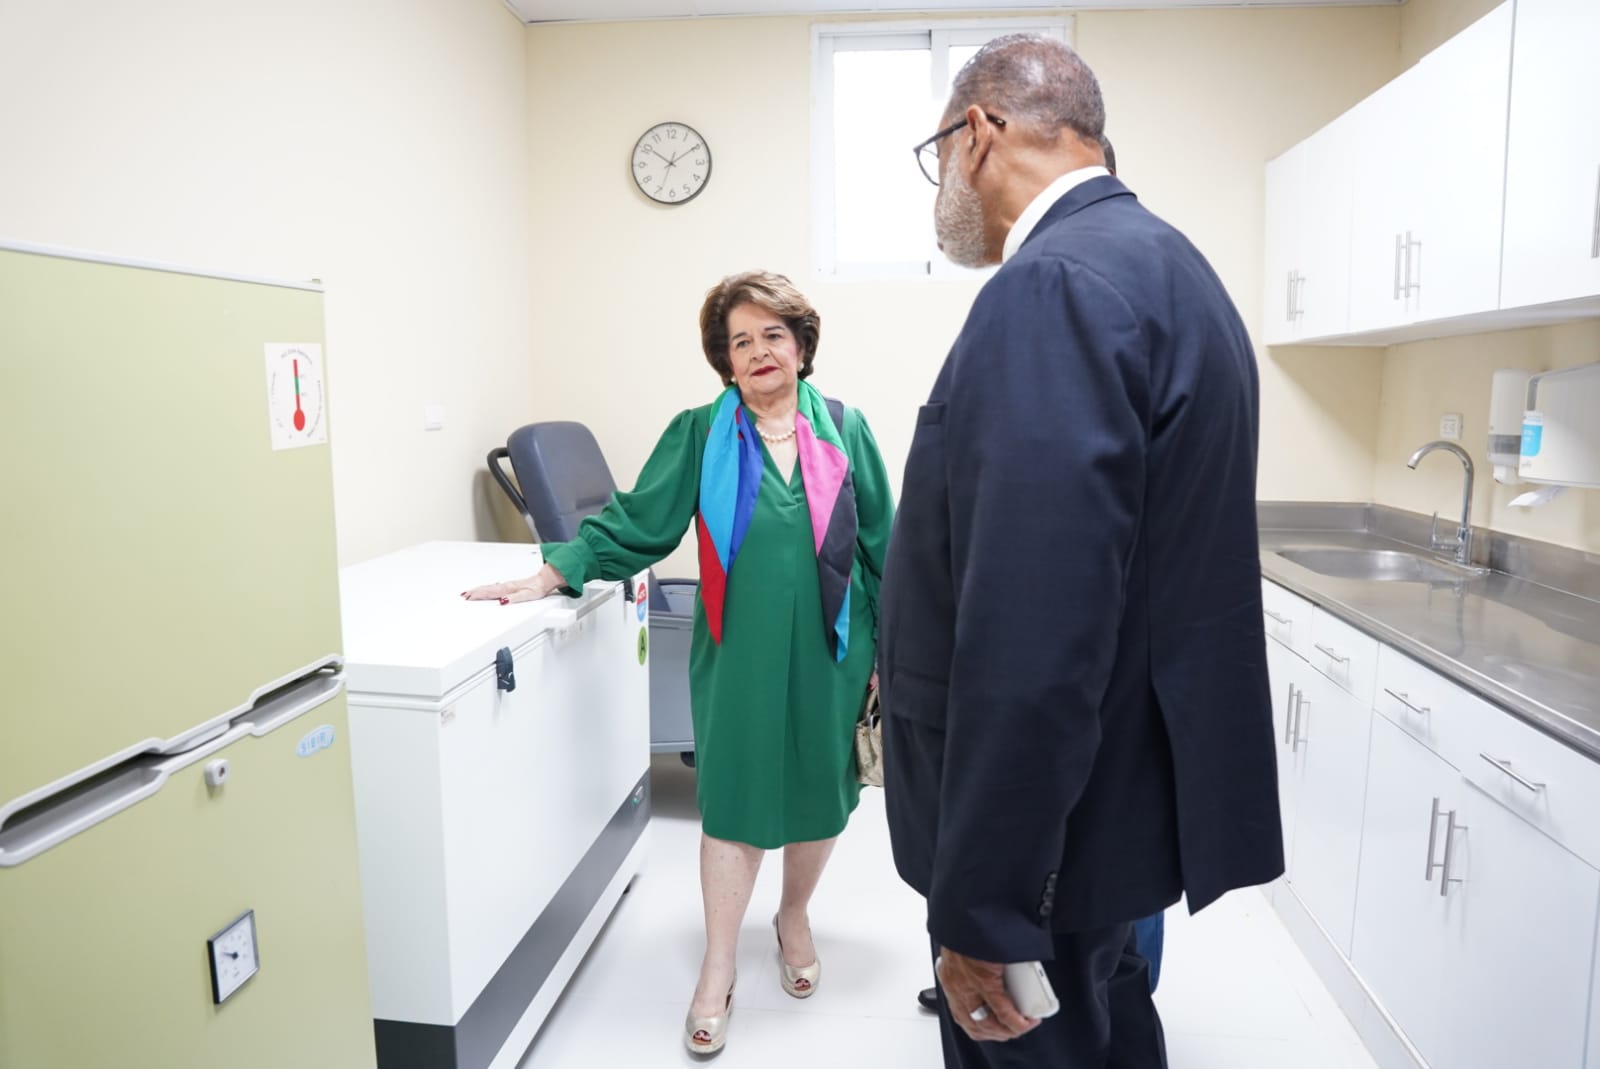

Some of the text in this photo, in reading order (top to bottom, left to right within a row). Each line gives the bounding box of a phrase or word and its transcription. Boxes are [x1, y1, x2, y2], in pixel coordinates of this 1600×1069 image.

[652, 134, 662, 144] 11
[666, 129, 677, 139] 12
[683, 132, 689, 142] 1
[641, 143, 653, 155] 10
[638, 161, 647, 169] 9
[643, 175, 652, 184] 8
[693, 173, 701, 182] 4
[654, 185, 663, 194] 7
[669, 188, 676, 198] 6
[682, 183, 691, 194] 5
[640, 636, 647, 655] A
